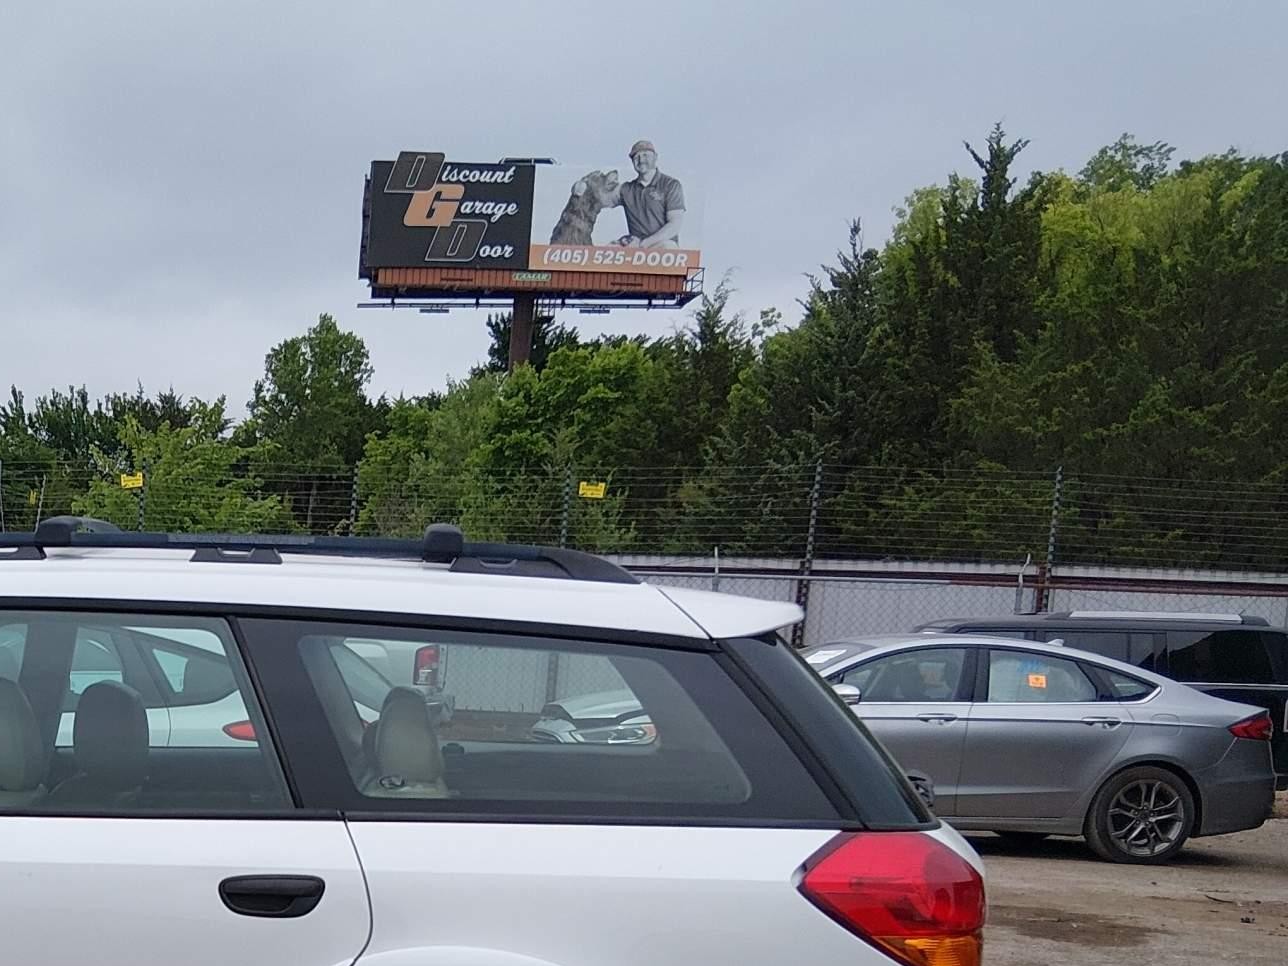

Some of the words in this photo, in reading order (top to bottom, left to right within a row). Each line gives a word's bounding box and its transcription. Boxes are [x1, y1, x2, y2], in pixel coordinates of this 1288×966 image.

[384, 150, 516, 193] Discount
[403, 183, 518, 226] Garage
[425, 218, 514, 262] Door
[543, 248, 588, 266] (405)
[593, 250, 688, 267] 525-DOOR
